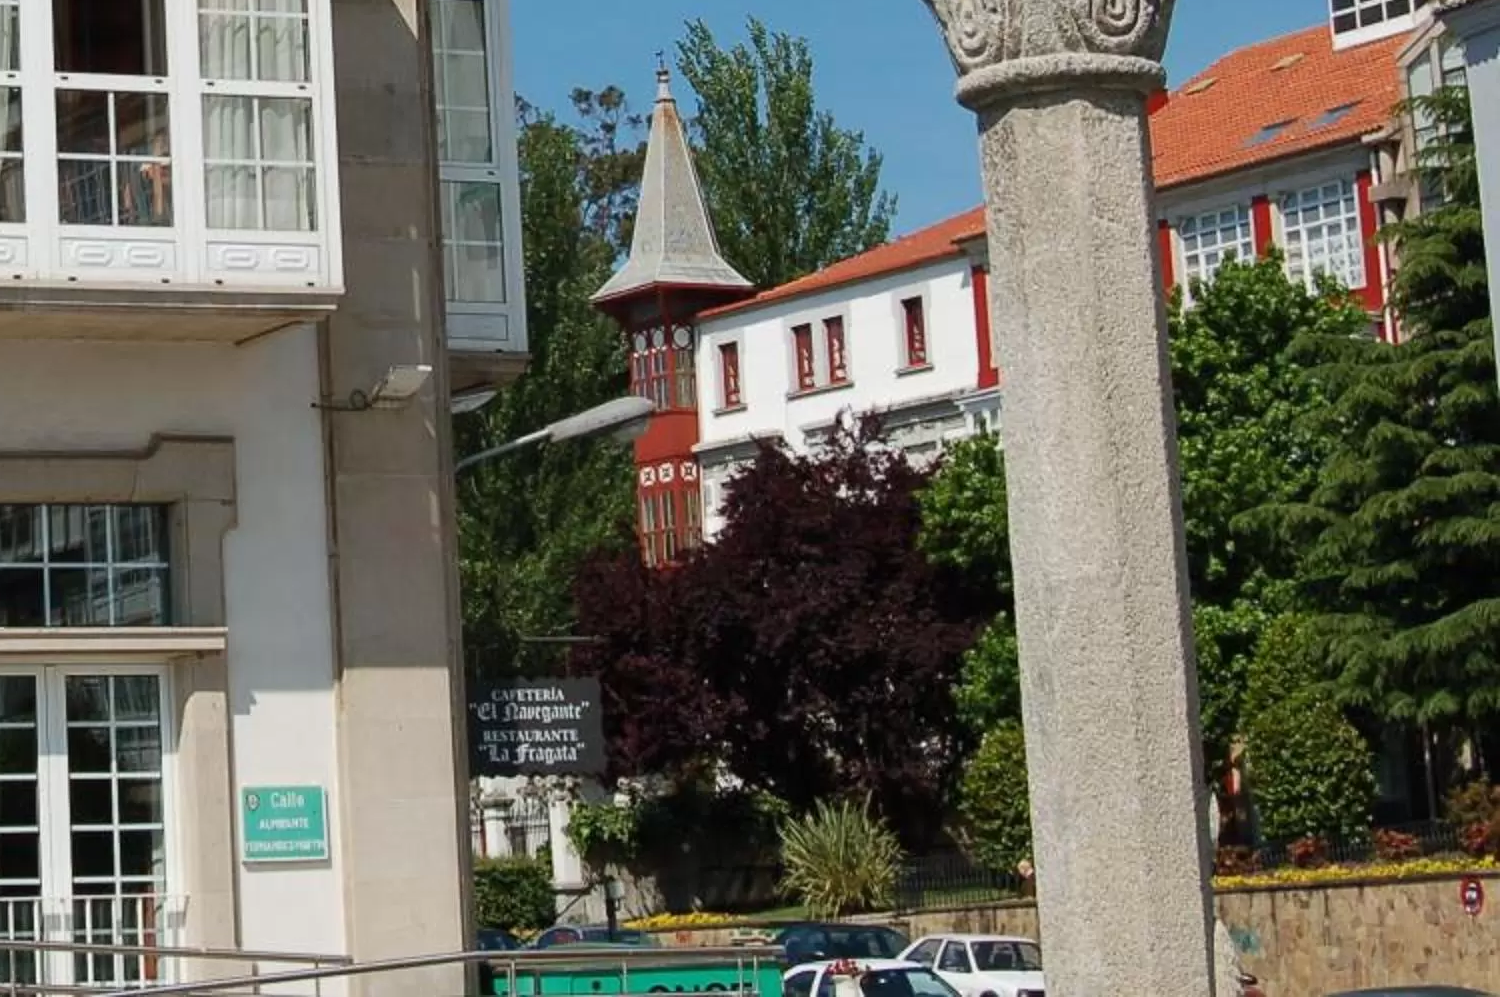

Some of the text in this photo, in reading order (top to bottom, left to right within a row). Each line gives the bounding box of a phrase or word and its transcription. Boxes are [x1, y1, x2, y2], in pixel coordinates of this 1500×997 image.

[491, 686, 565, 702] CAFETERÍA
[483, 728, 580, 742] RESTAURANTE
[270, 791, 305, 808] Calle
